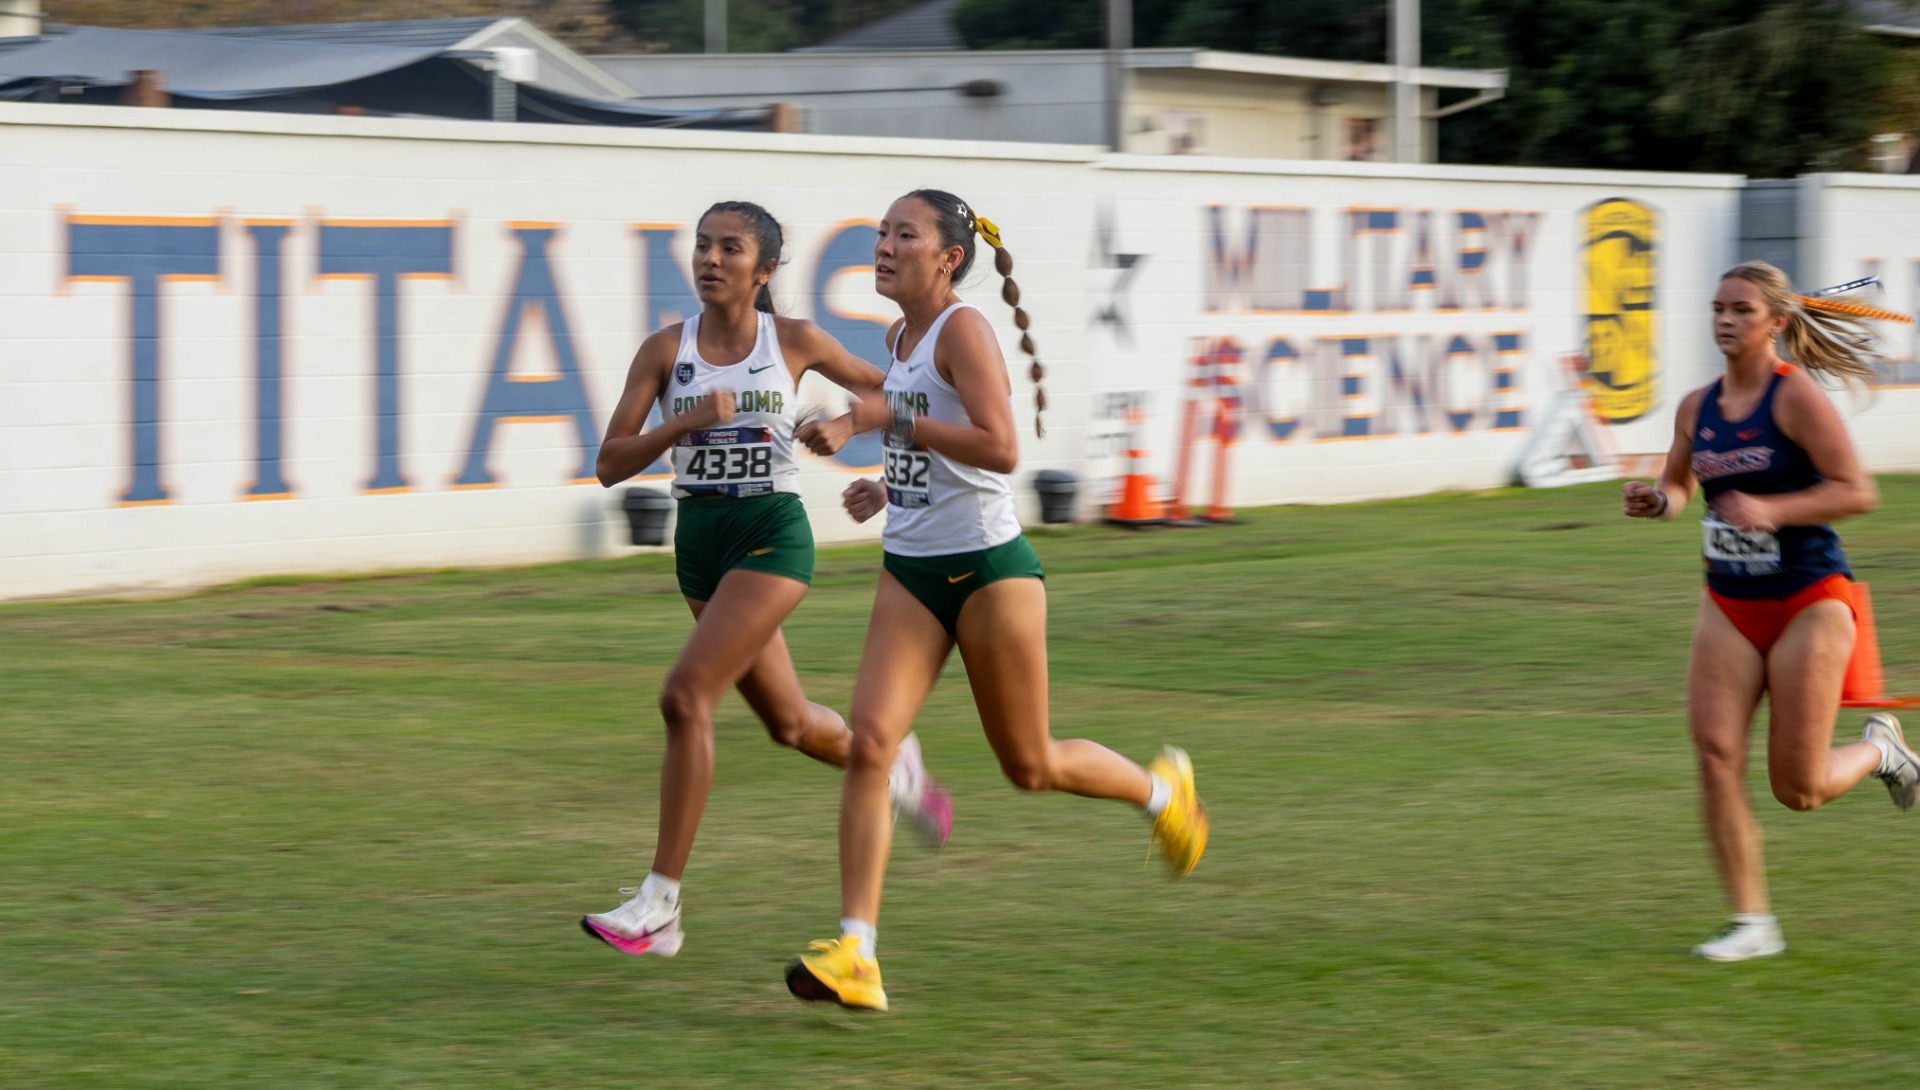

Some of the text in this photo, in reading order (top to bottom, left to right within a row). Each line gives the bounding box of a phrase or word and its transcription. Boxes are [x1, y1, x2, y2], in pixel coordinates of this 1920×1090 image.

[1202, 205, 1541, 314] MILITARY
[686, 446, 772, 480] 4338
[885, 449, 931, 488] 332
